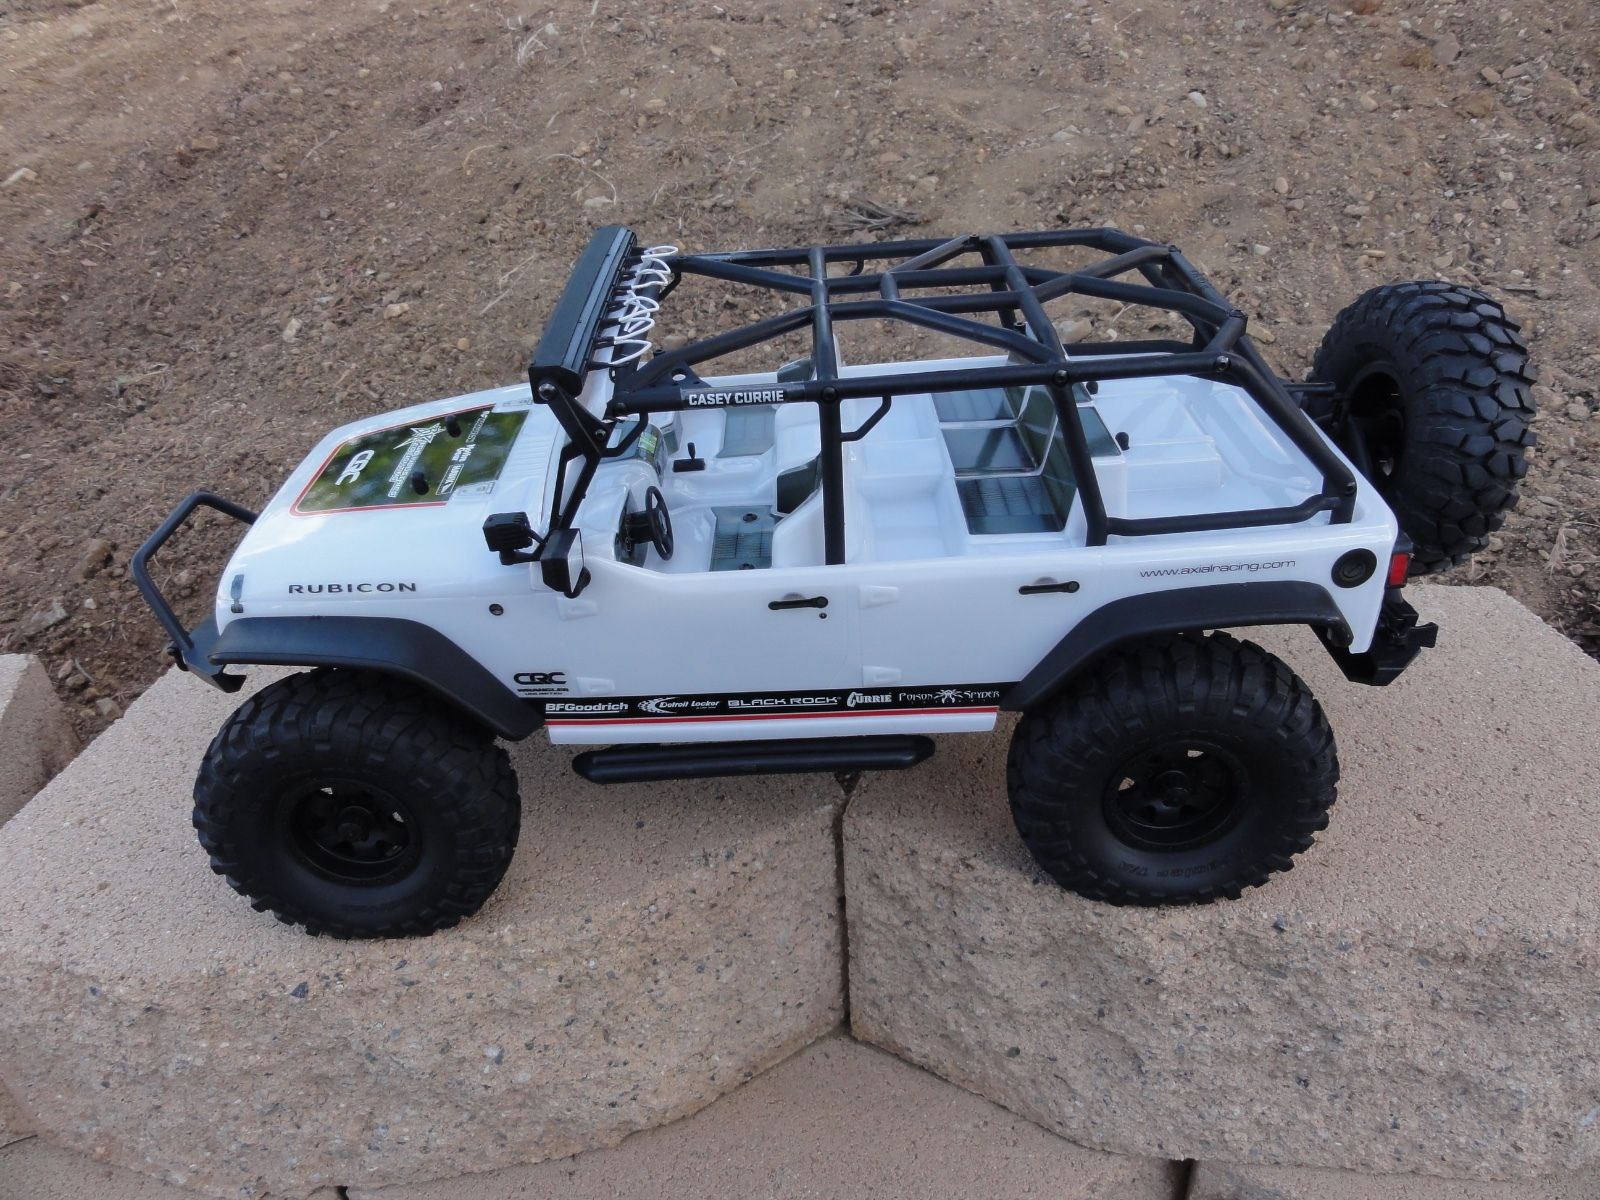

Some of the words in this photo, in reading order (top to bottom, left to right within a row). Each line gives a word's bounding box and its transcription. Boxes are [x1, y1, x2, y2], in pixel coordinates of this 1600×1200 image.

[688, 392, 732, 406] CASEY
[734, 390, 785, 404] CURRIE
[1140, 560, 1296, 578] www.axialracing.com
[288, 582, 417, 594] RUBICON
[513, 672, 567, 685] CRC
[545, 702, 629, 712] BFGoodrich
[727, 698, 788, 708] BLACK
[789, 697, 838, 706] ROCK
